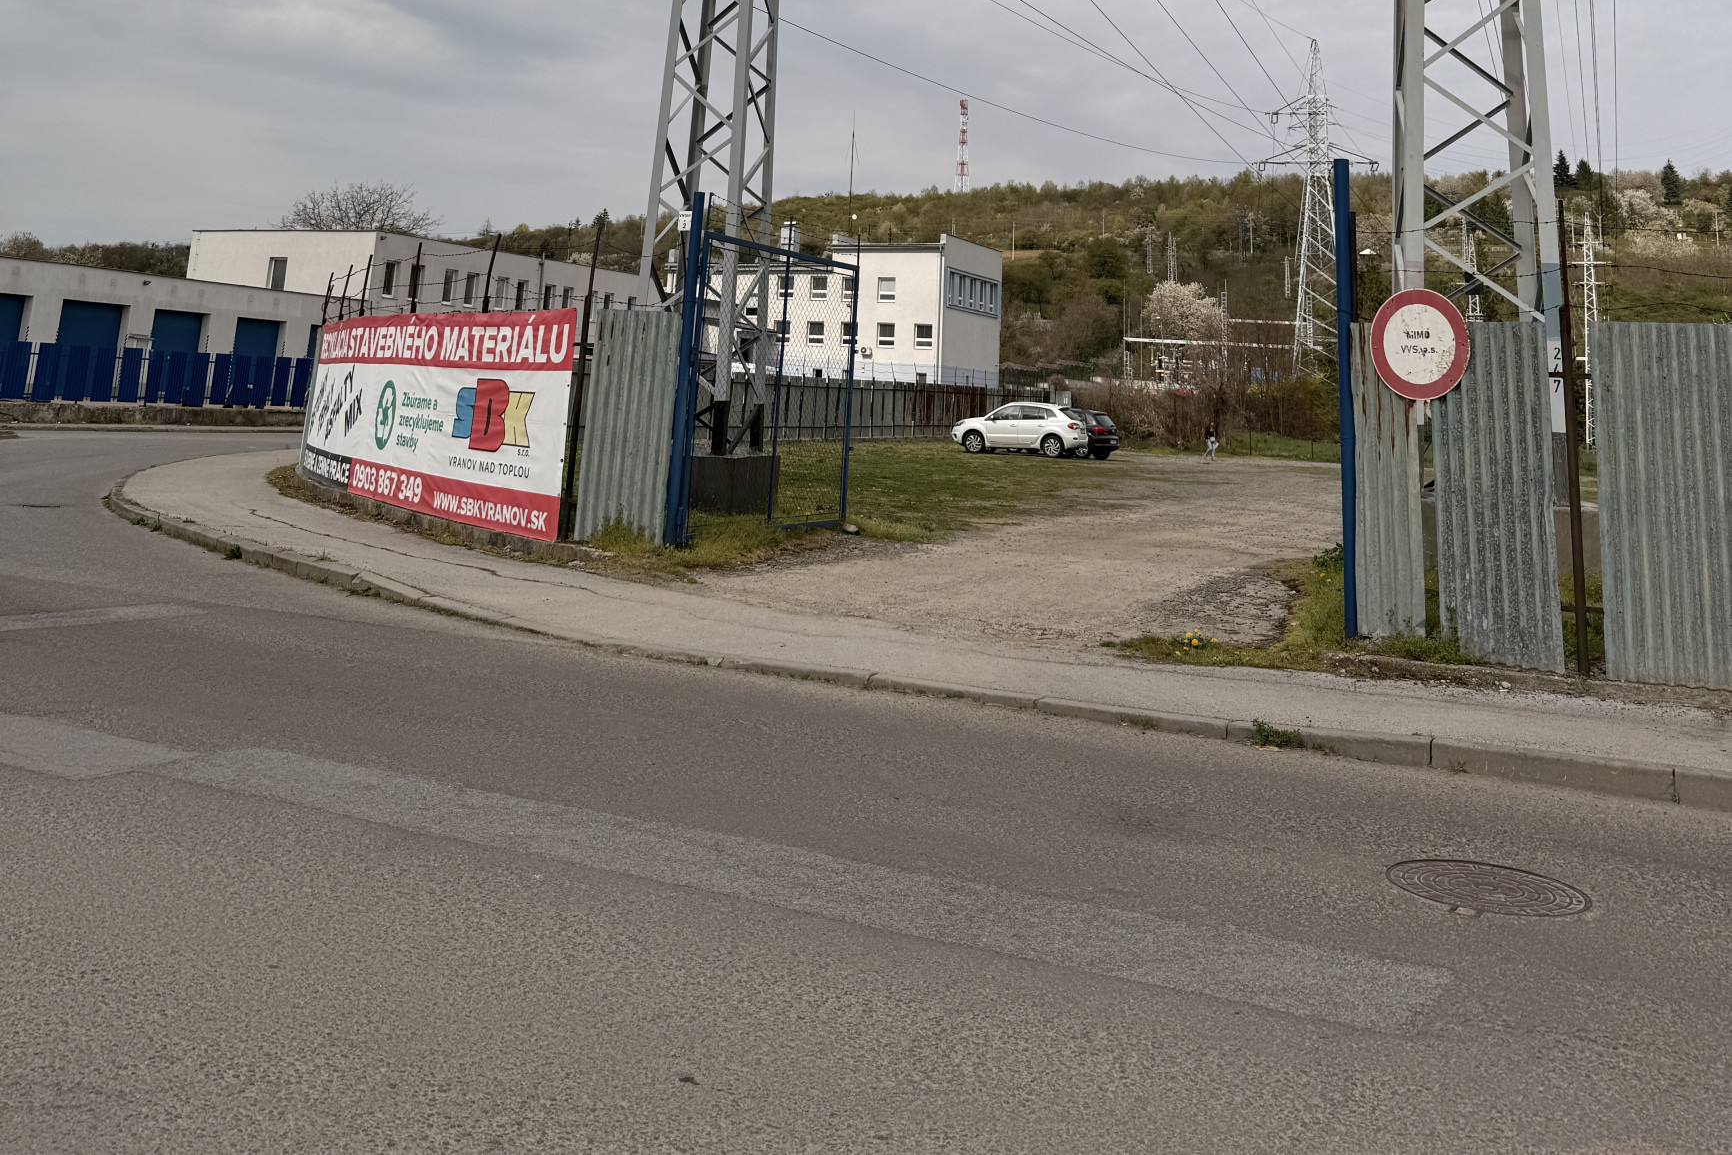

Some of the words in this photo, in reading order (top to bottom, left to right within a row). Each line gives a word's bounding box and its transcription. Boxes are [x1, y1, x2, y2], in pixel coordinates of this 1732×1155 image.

[348, 316, 439, 361] STAVEBNÉHO
[439, 314, 570, 364] MATERIÁLU
[344, 387, 363, 438] MIX
[401, 391, 432, 410] Zbúrame
[432, 402, 438, 410] a
[451, 377, 536, 453] SBK
[398, 414, 444, 434] zrecyklujeme
[395, 432, 419, 453] stavby
[329, 456, 350, 483] PRÁCE
[448, 455, 477, 471] VRANOV
[479, 460, 496, 474] NAD
[352, 463, 377, 492] 0903
[377, 468, 398, 497] 867
[398, 473, 423, 504] 349
[433, 490, 548, 532] WWW.SBKVRANOV.SK
